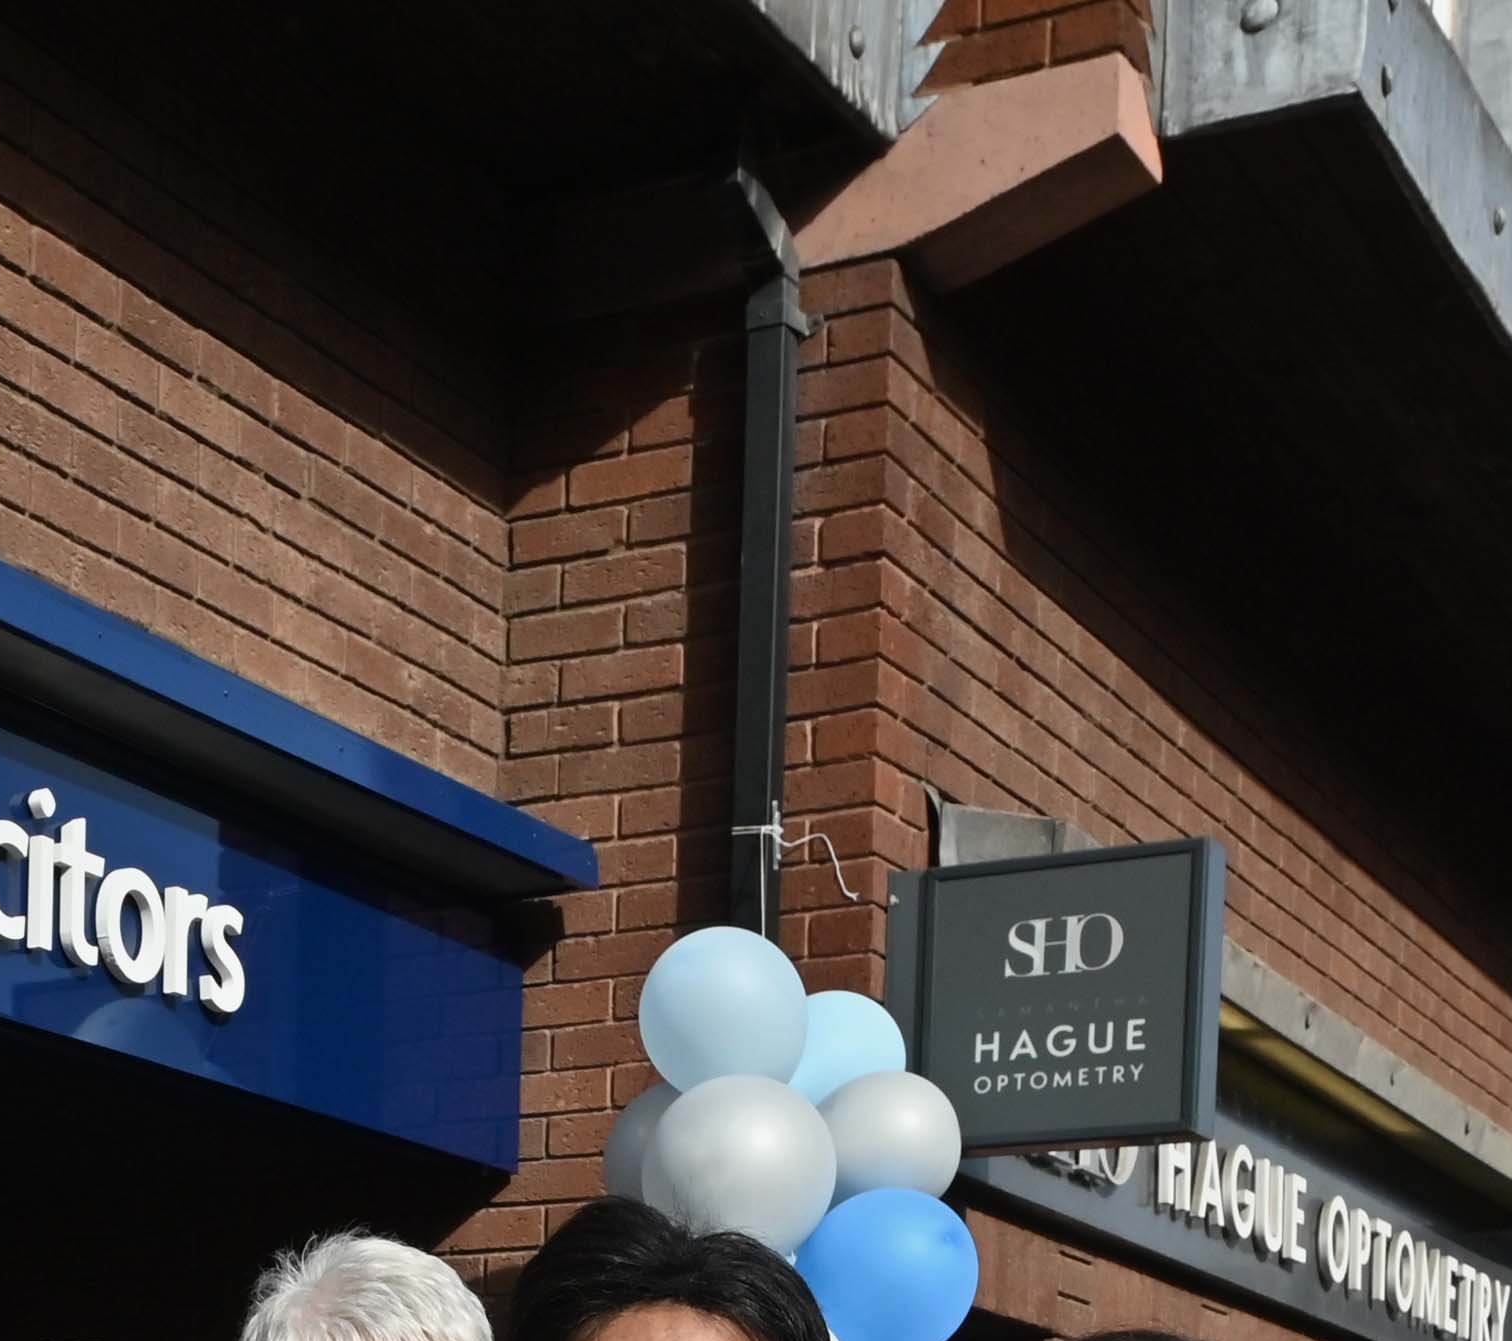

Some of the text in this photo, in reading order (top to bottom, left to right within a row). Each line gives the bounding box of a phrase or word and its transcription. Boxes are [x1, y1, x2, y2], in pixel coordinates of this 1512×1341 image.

[974, 1018, 1147, 1064] HAGUE
[973, 1063, 1145, 1095] OPTOMETRY
[1157, 1139, 1307, 1264] HAGUE
